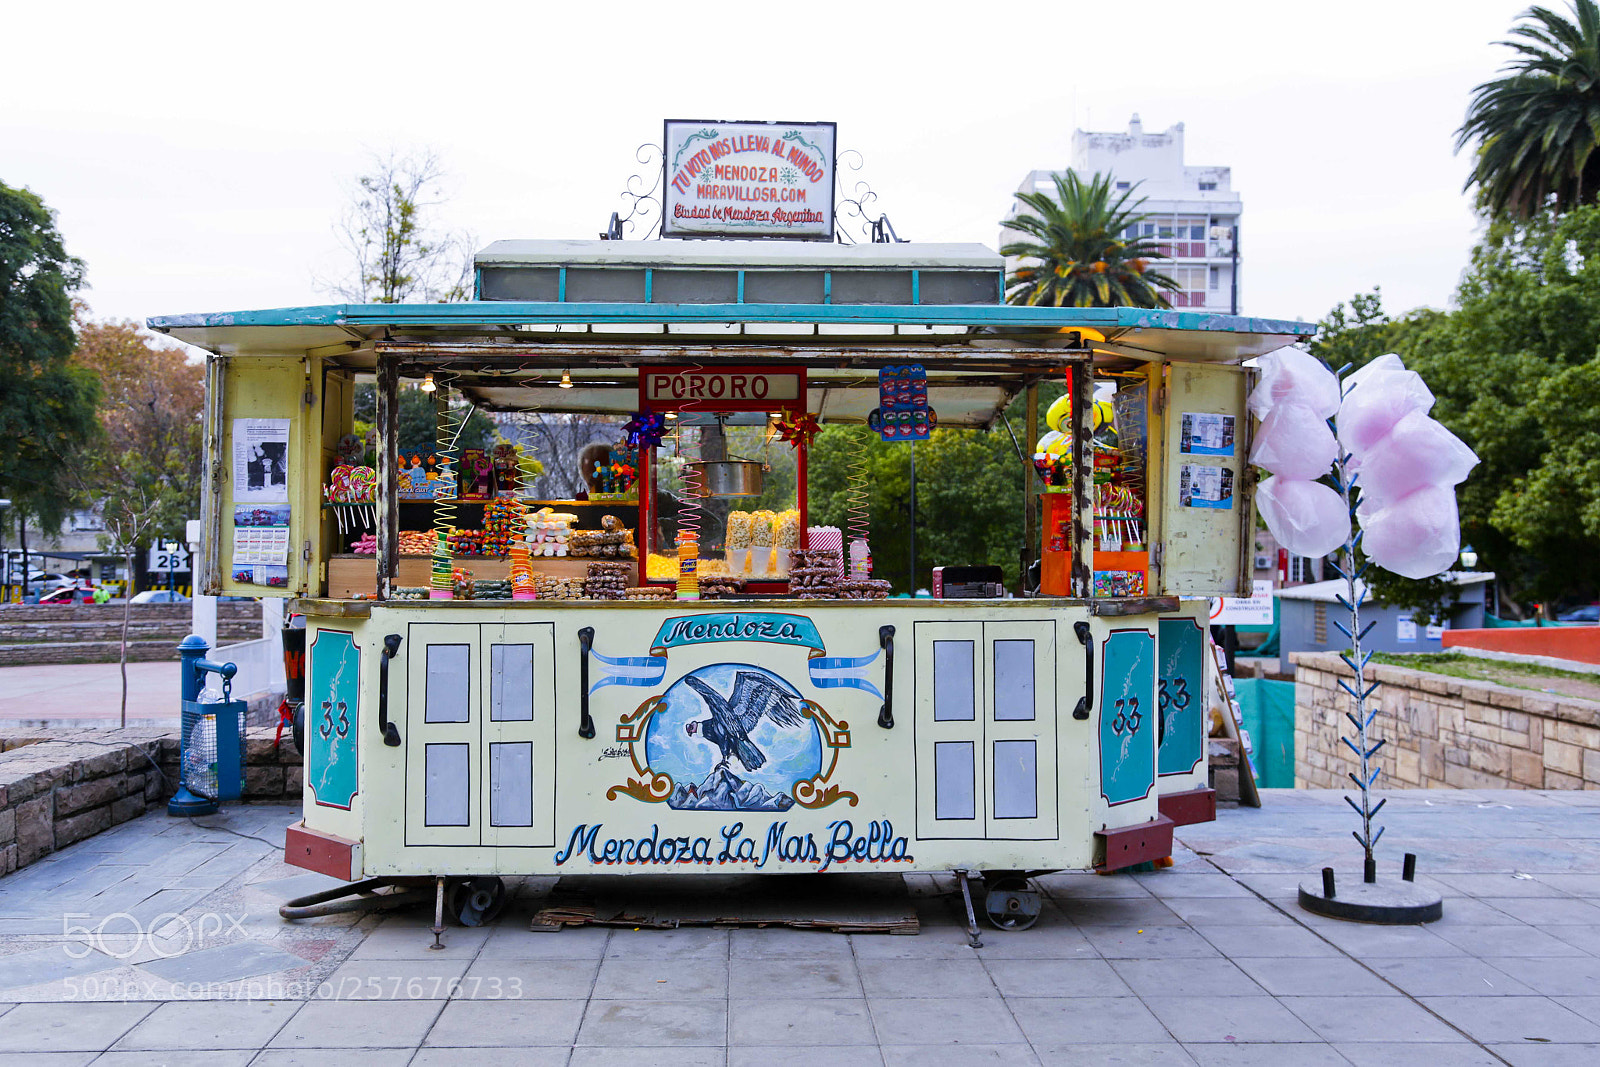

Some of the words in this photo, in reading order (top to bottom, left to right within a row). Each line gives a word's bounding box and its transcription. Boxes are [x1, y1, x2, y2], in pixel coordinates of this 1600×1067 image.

[671, 169, 691, 195] TU
[684, 148, 712, 179] VOTO
[708, 138, 732, 162] NOS
[731, 134, 770, 153] LLEVA
[771, 139, 786, 158] AL
[786, 145, 824, 184] MUNDO
[714, 164, 778, 183] MENDOZA
[696, 184, 807, 203] MARAVILLOSA.COM
[674, 202, 711, 219] Ciudad
[722, 206, 770, 222] Mendoza
[653, 375, 769, 399] PORORO
[157, 555, 190, 568] 261
[662, 615, 802, 646] Mendoza
[319, 698, 350, 741] 33
[1111, 693, 1143, 737] 33
[553, 823, 714, 866] Mendoza
[715, 821, 759, 864] La
[754, 821, 821, 870] Mas
[817, 819, 914, 872] Bella
